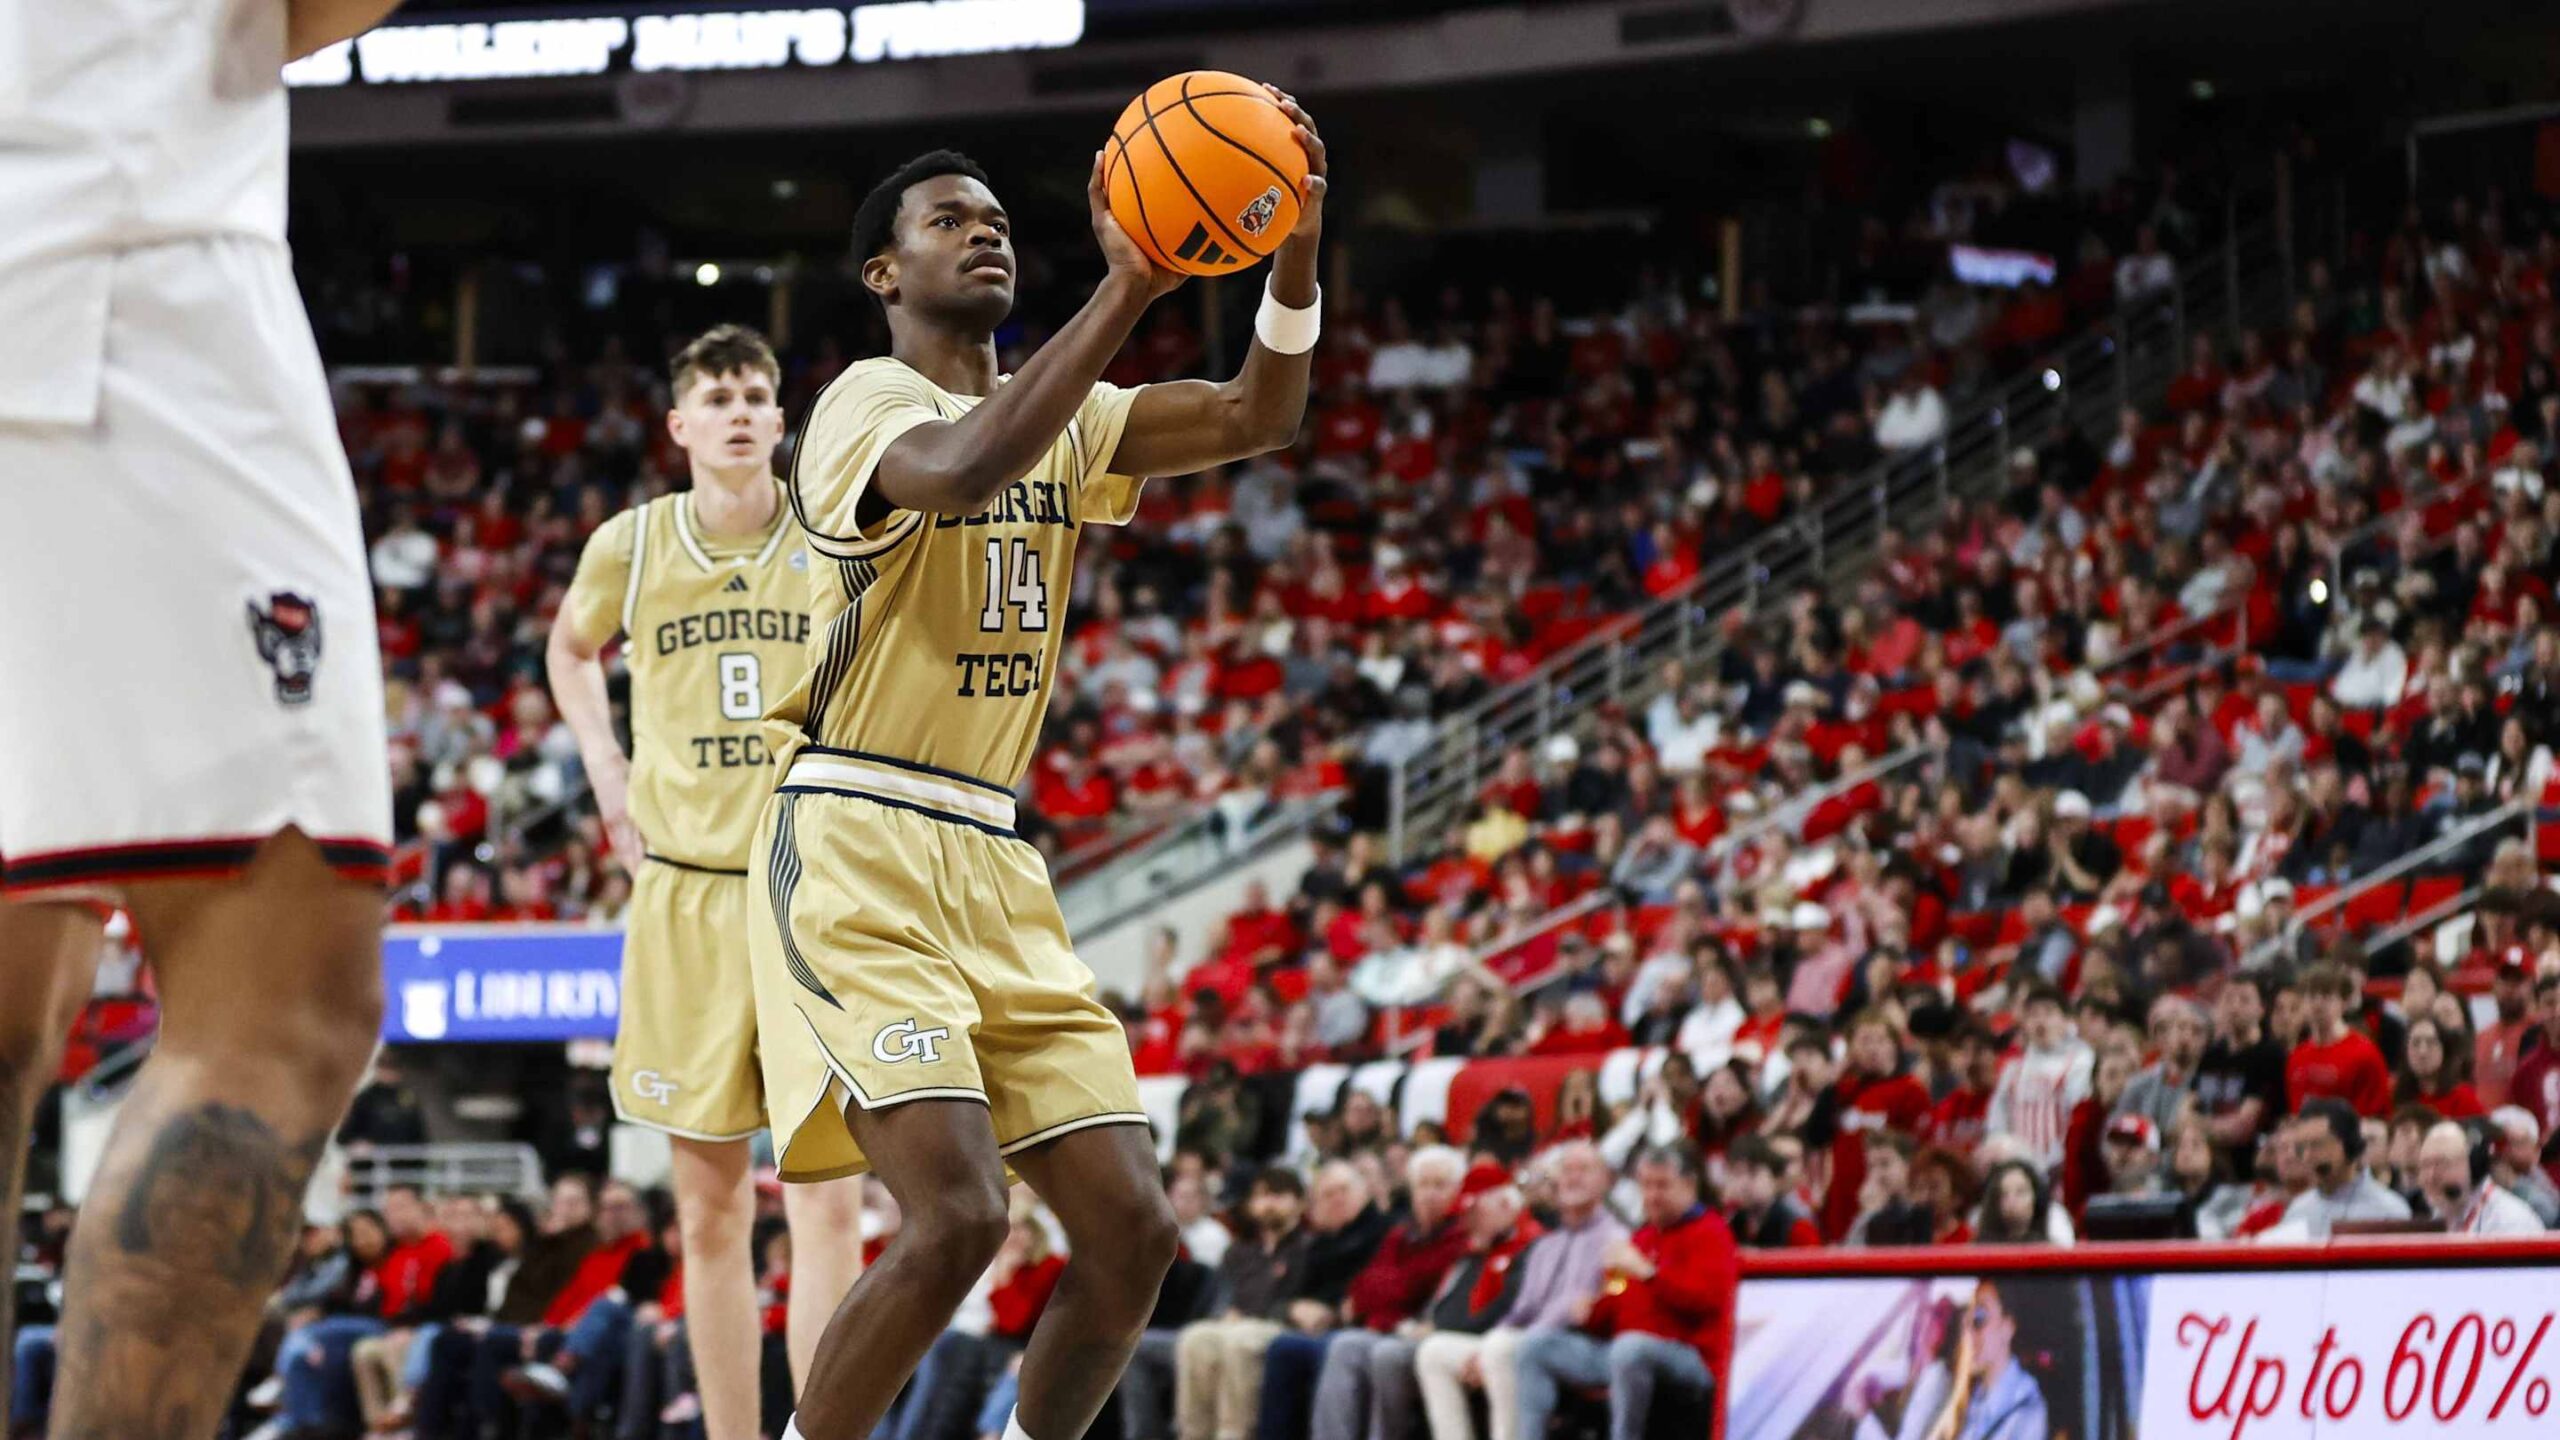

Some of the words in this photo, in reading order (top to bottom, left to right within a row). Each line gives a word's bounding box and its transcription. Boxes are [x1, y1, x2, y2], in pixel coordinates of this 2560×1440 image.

[935, 480, 1075, 530] ORGI
[980, 537, 1047, 632] 14
[718, 652, 763, 721] 8
[691, 735, 776, 769] TEC
[872, 1017, 949, 1064] GT
[631, 1069, 680, 1106] GT
[2177, 1312, 2287, 1440] Up
[2300, 1325, 2364, 1421] to
[2384, 1312, 2555, 1422] 60%
